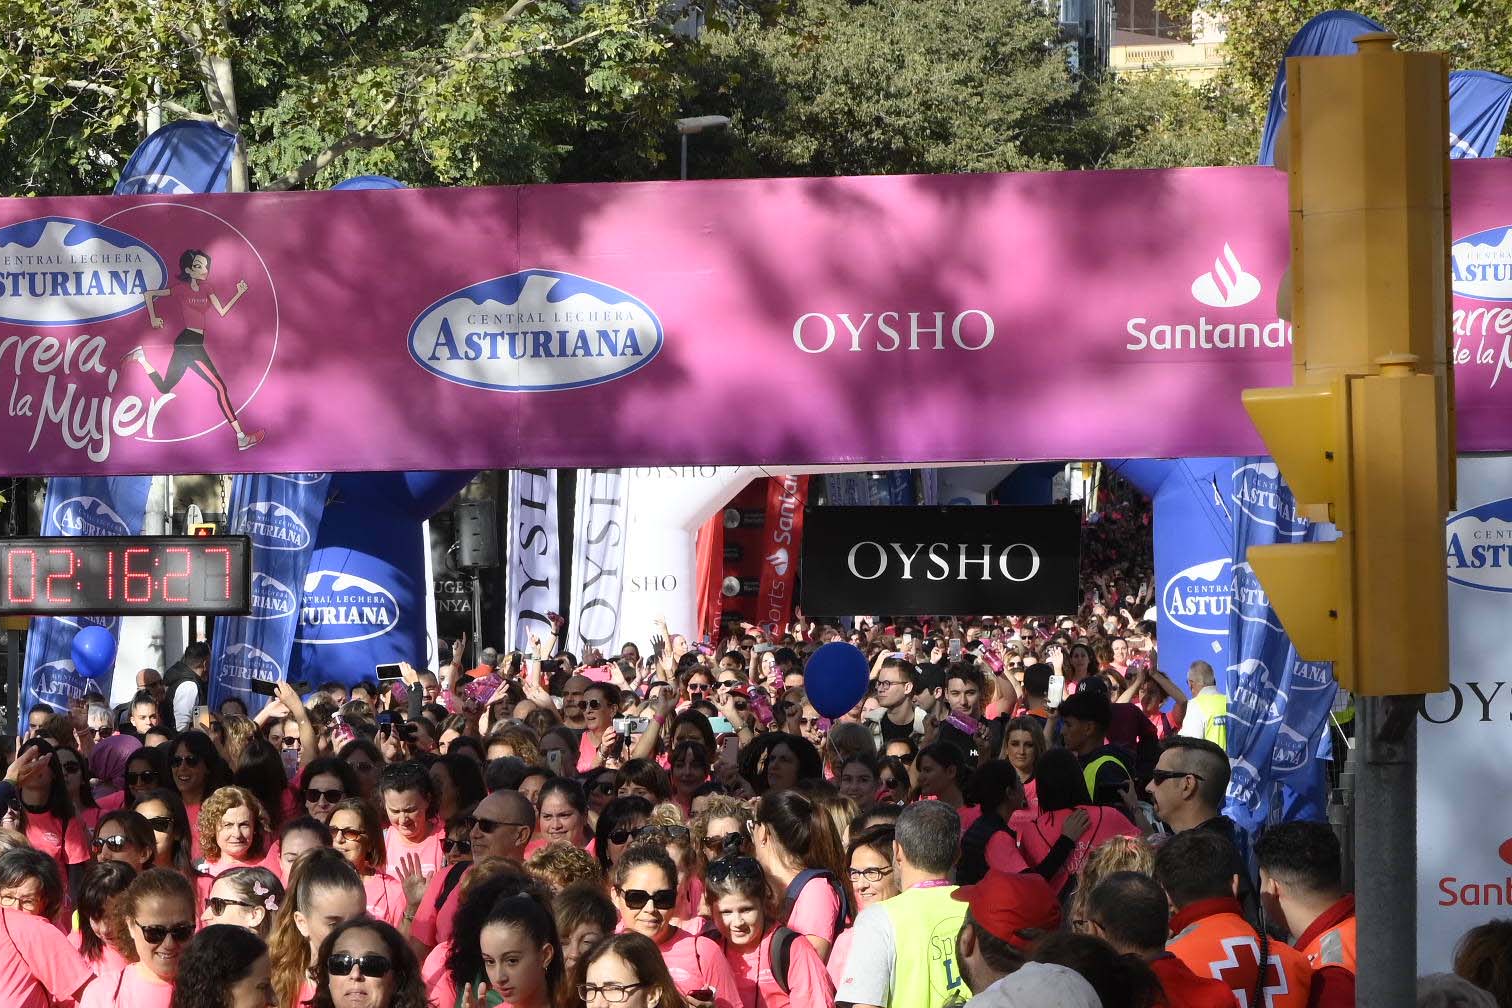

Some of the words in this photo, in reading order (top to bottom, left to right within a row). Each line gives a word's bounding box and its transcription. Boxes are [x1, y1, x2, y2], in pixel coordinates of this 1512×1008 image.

[71, 253, 143, 266] LECHERA
[467, 313, 545, 325] CENTRAL
[554, 311, 635, 324] LECHERA
[793, 309, 996, 354] OYSHO
[1126, 317, 1294, 352] Santand
[428, 317, 645, 362] ASTURIANA
[1476, 335, 1494, 365] la
[8, 377, 33, 418] la
[29, 369, 177, 464] Mujer
[8, 548, 231, 603] 02:16:27
[847, 541, 1041, 582] OYSHO
[337, 596, 385, 604] LECHERA
